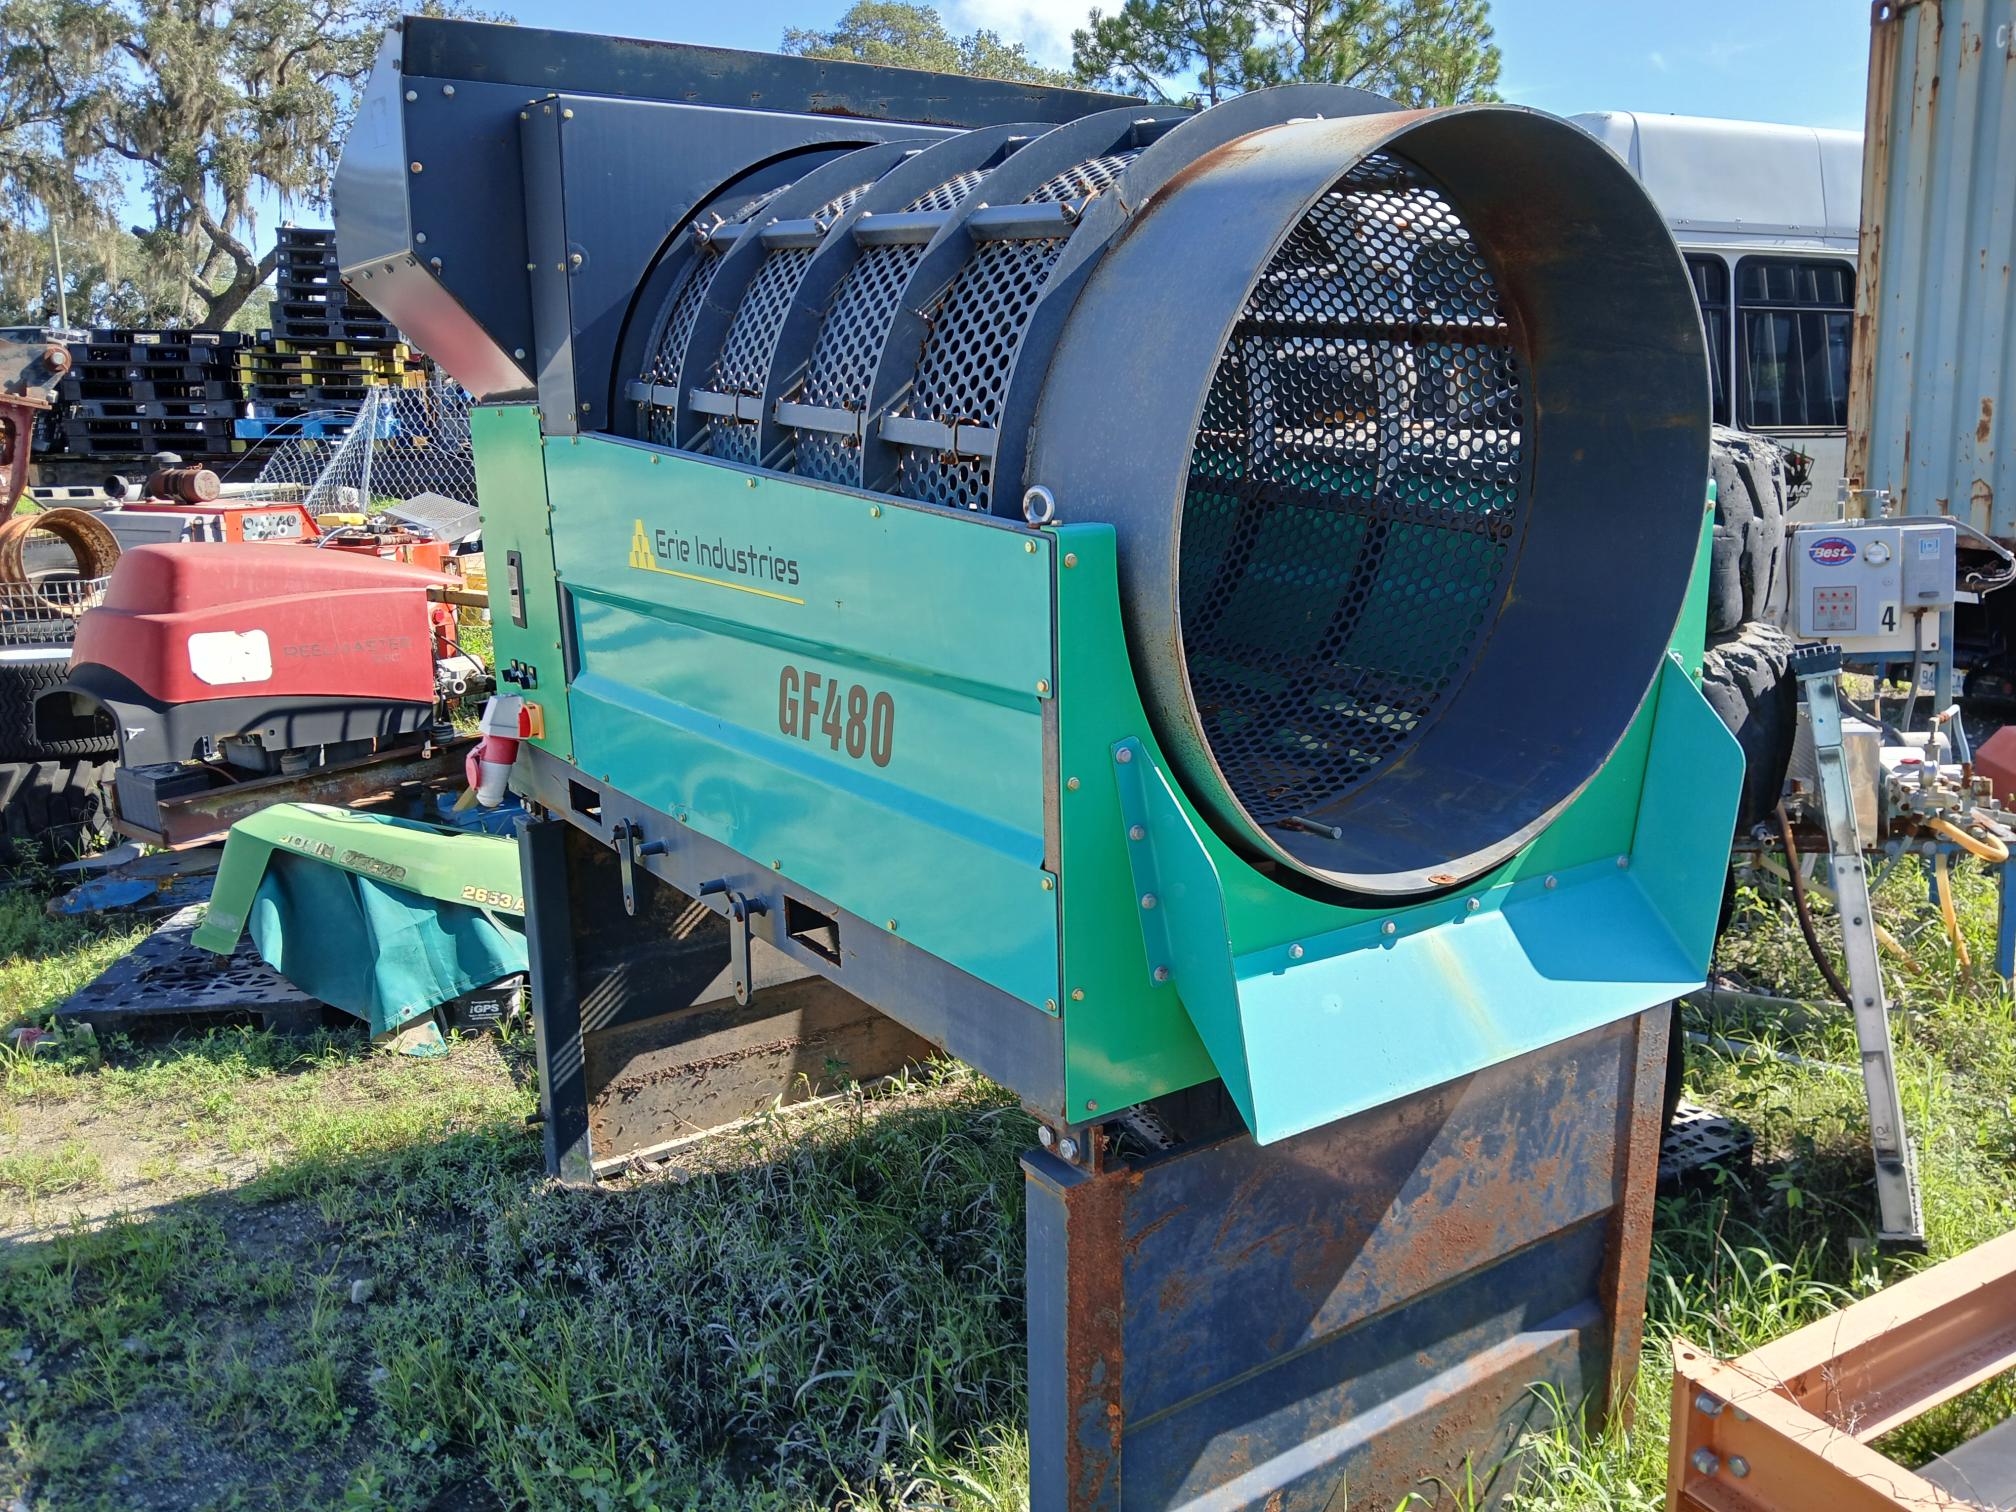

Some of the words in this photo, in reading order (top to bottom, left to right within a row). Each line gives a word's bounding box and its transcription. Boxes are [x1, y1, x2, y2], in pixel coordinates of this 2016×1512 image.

[655, 529, 690, 562] Erie
[695, 535, 799, 585] Industries
[1813, 546, 1852, 558] Best
[1881, 606, 1897, 632] 4
[778, 664, 895, 768] GF480
